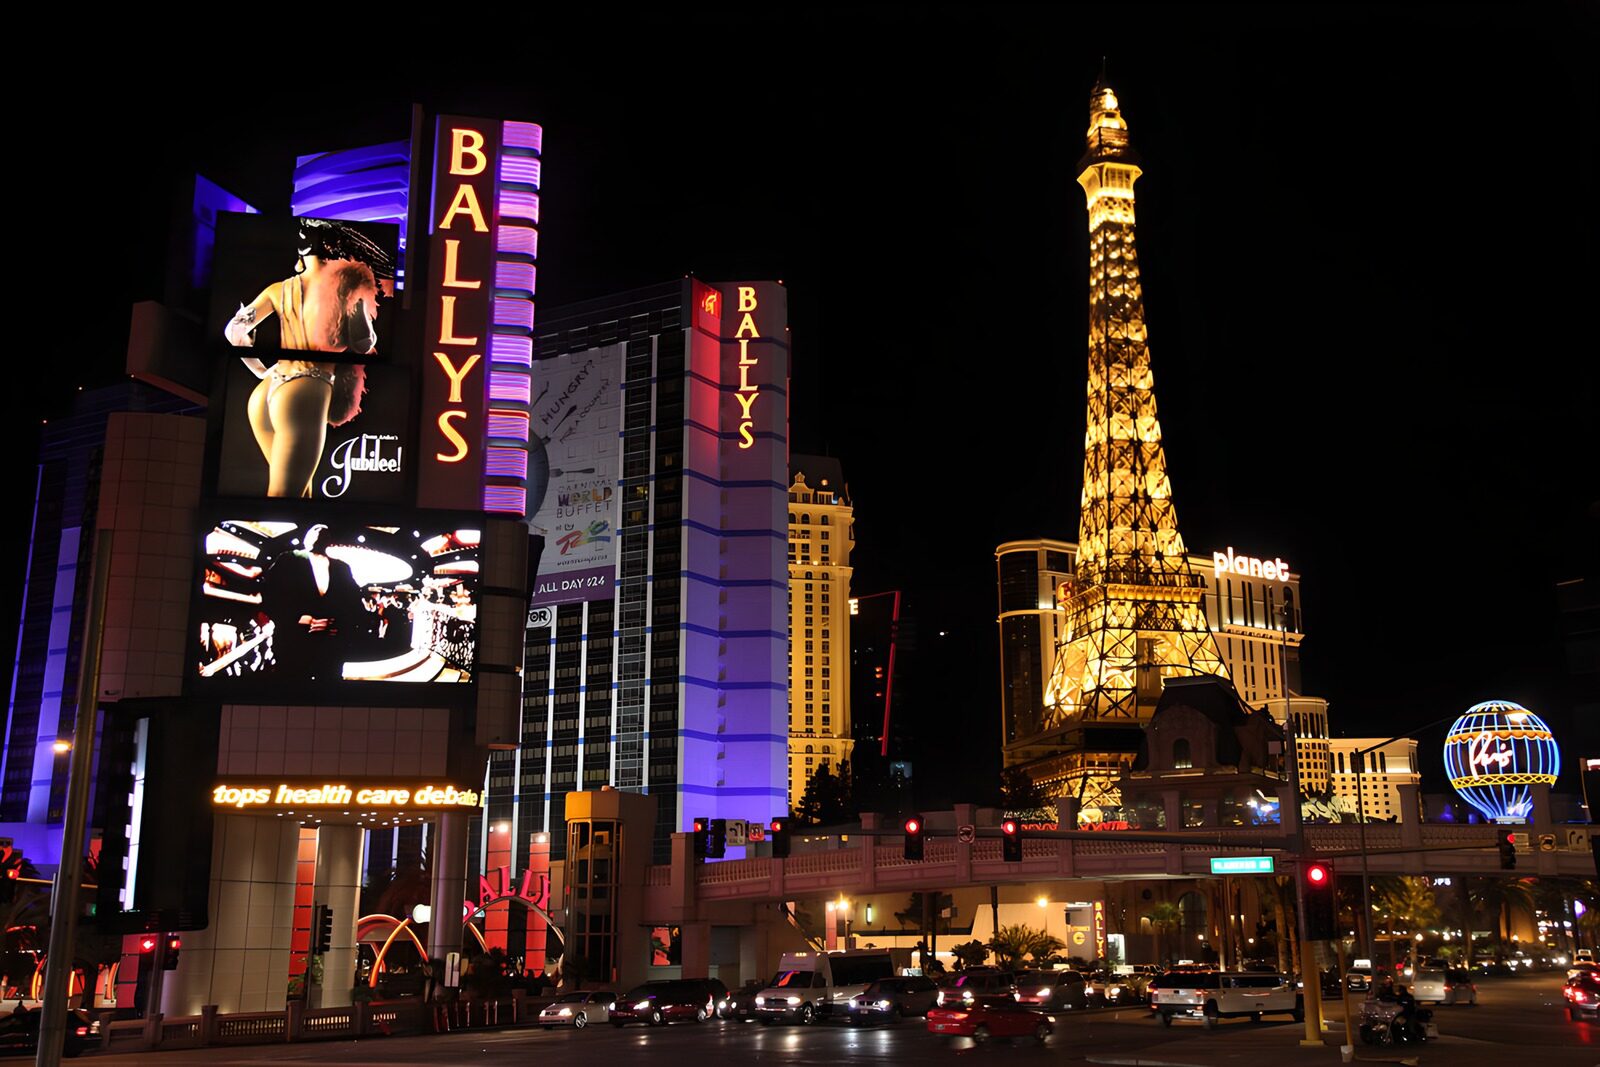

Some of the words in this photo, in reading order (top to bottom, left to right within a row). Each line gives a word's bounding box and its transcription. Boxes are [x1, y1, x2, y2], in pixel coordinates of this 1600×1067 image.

[433, 128, 490, 462] BALLYS
[734, 286, 760, 449] BALLYS
[321, 436, 402, 498] Jubilee!
[556, 499, 612, 519] BUFFET
[558, 486, 613, 507] WORLD
[1213, 546, 1290, 582] planet
[537, 582, 559, 594] ALL
[561, 578, 584, 591] DAY
[213, 784, 271, 808] tops
[275, 784, 352, 805] health
[356, 787, 410, 805] care
[413, 785, 479, 807] debate
